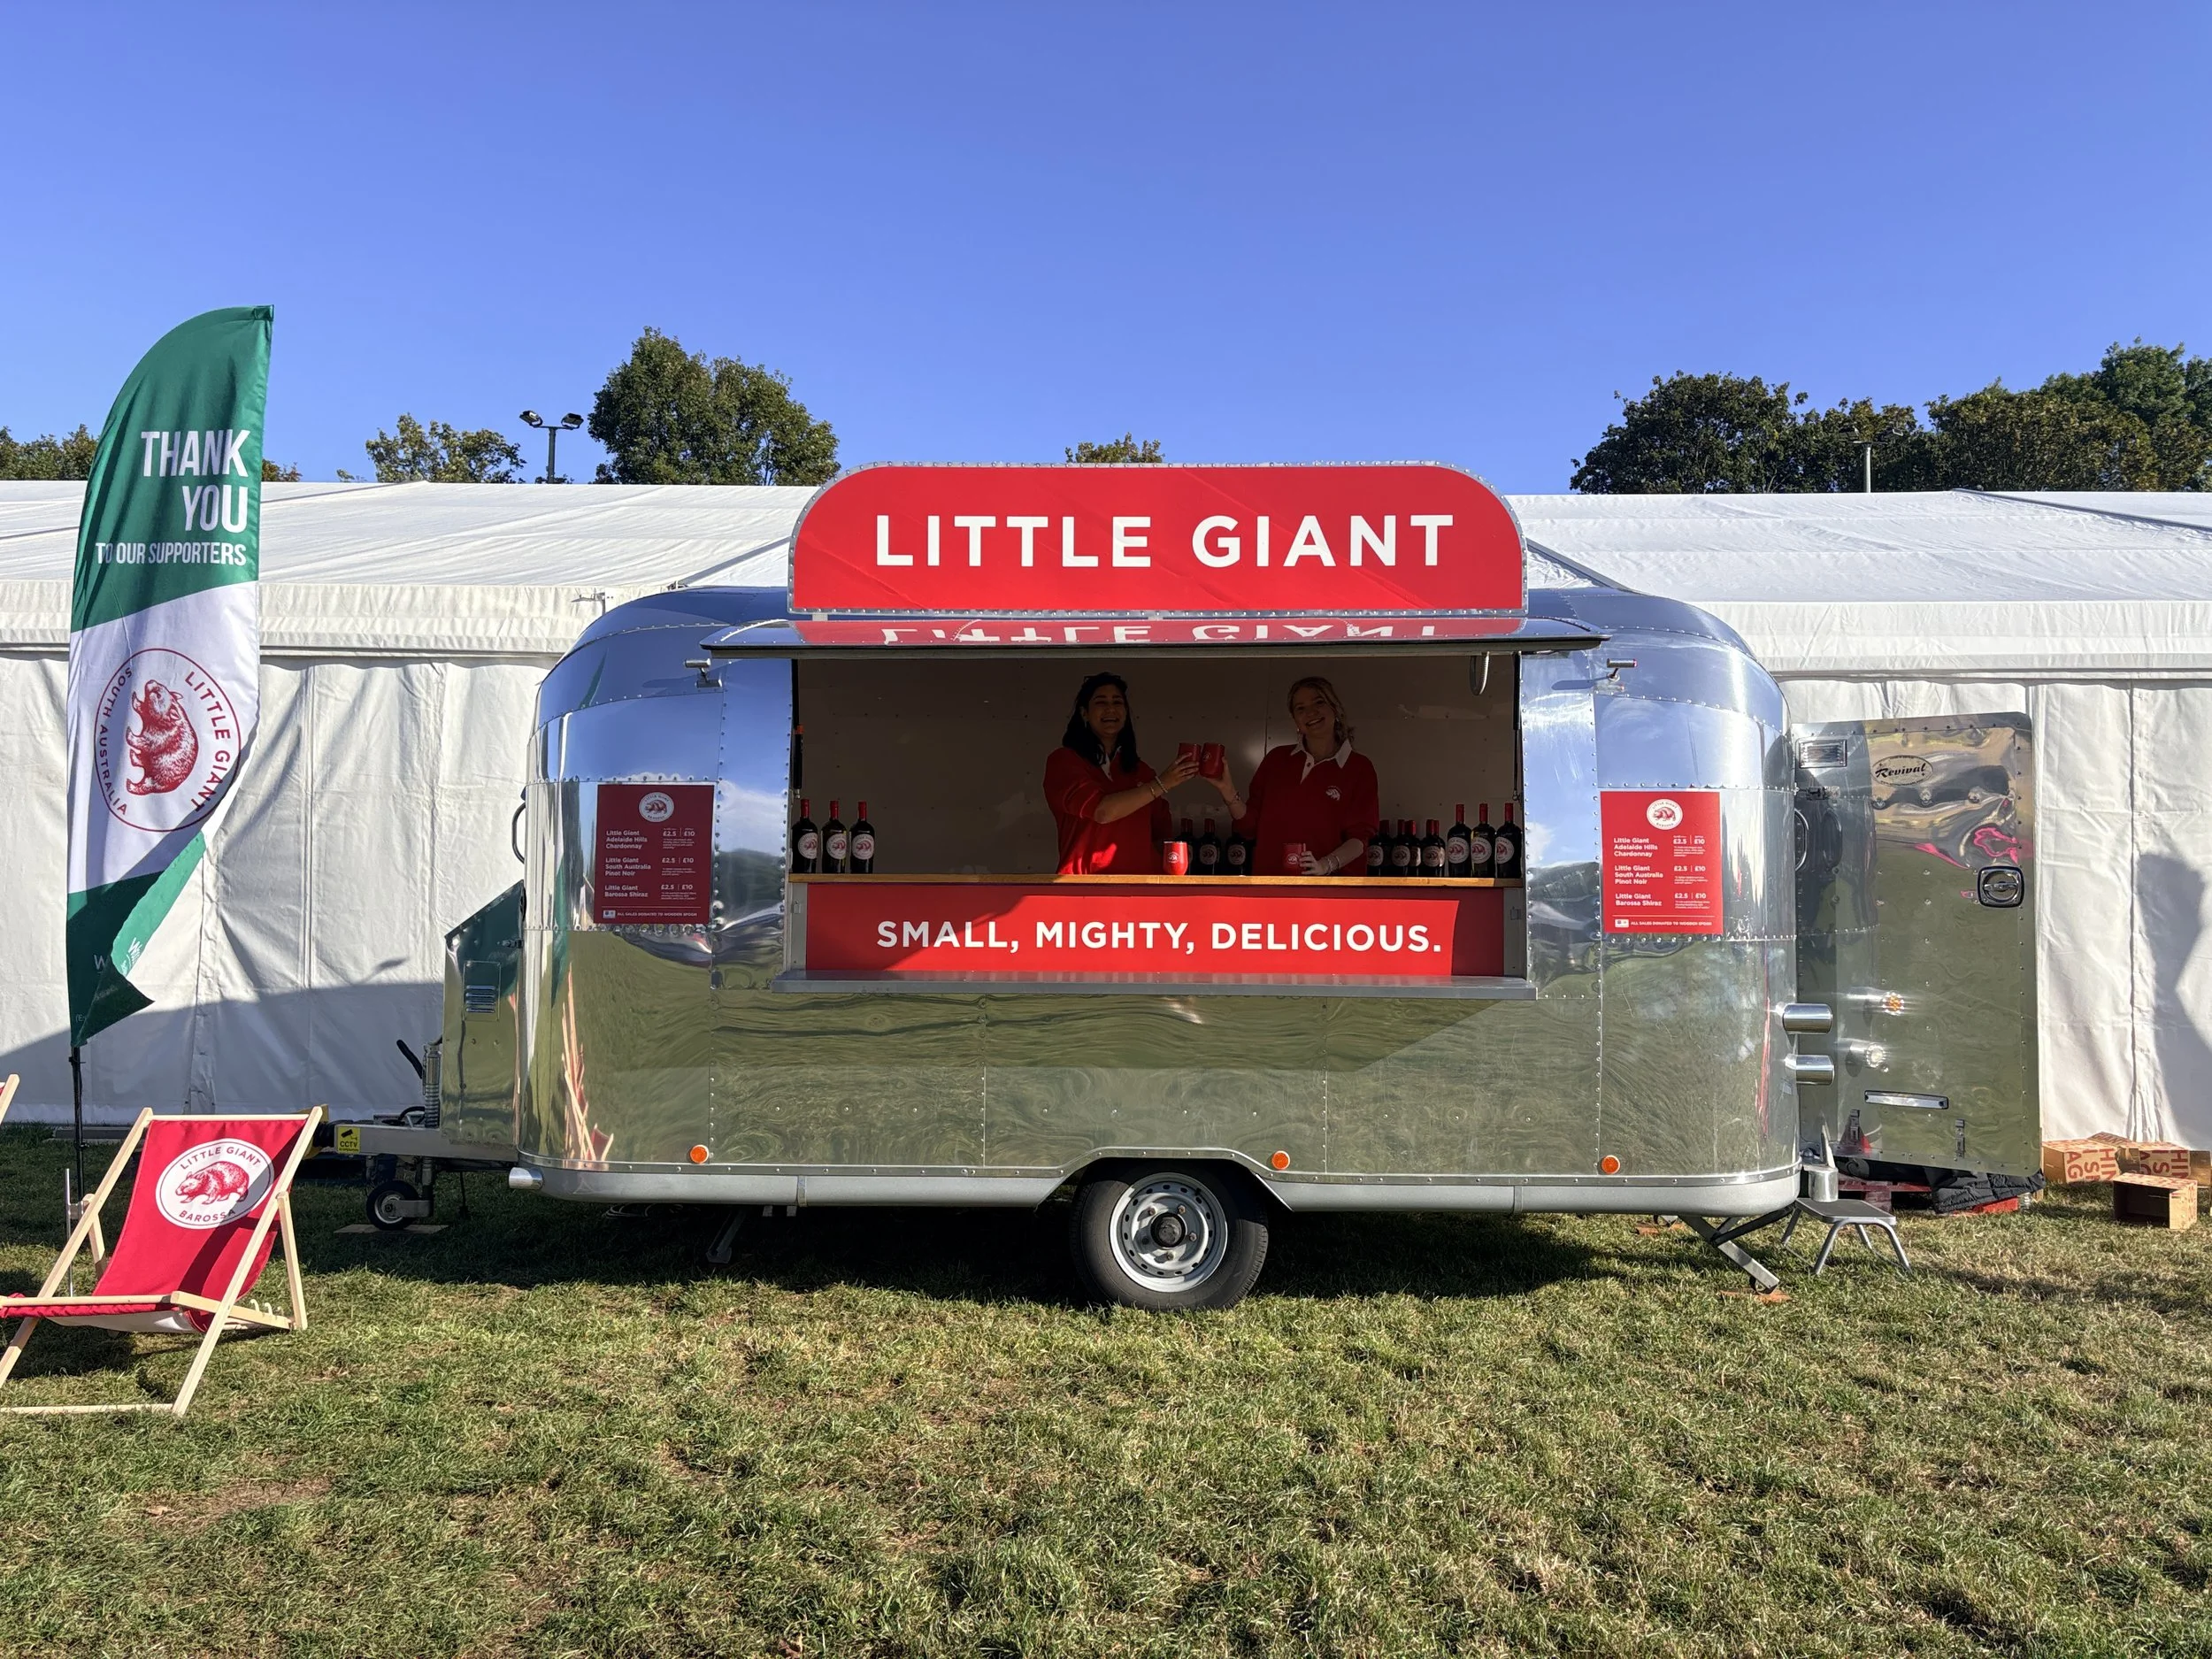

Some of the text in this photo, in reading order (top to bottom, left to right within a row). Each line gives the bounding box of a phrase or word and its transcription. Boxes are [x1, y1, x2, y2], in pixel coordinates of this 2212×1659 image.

[141, 429, 250, 477] THANK
[182, 485, 248, 533] YOU
[96, 541, 246, 565] TO OUR SUPPORTERS
[877, 515, 1453, 567] LITTLE GIANT
[99, 667, 133, 815] SOUTH AUSTRALIA
[184, 671, 231, 812] LITTLE GIANT
[1875, 763, 1926, 778] Revival
[878, 921, 1440, 954] SMALL, MIGHTY, DELICIOUS.
[180, 1146, 261, 1170] LITTLE GIANT
[179, 1210, 235, 1222] BAROSSA
